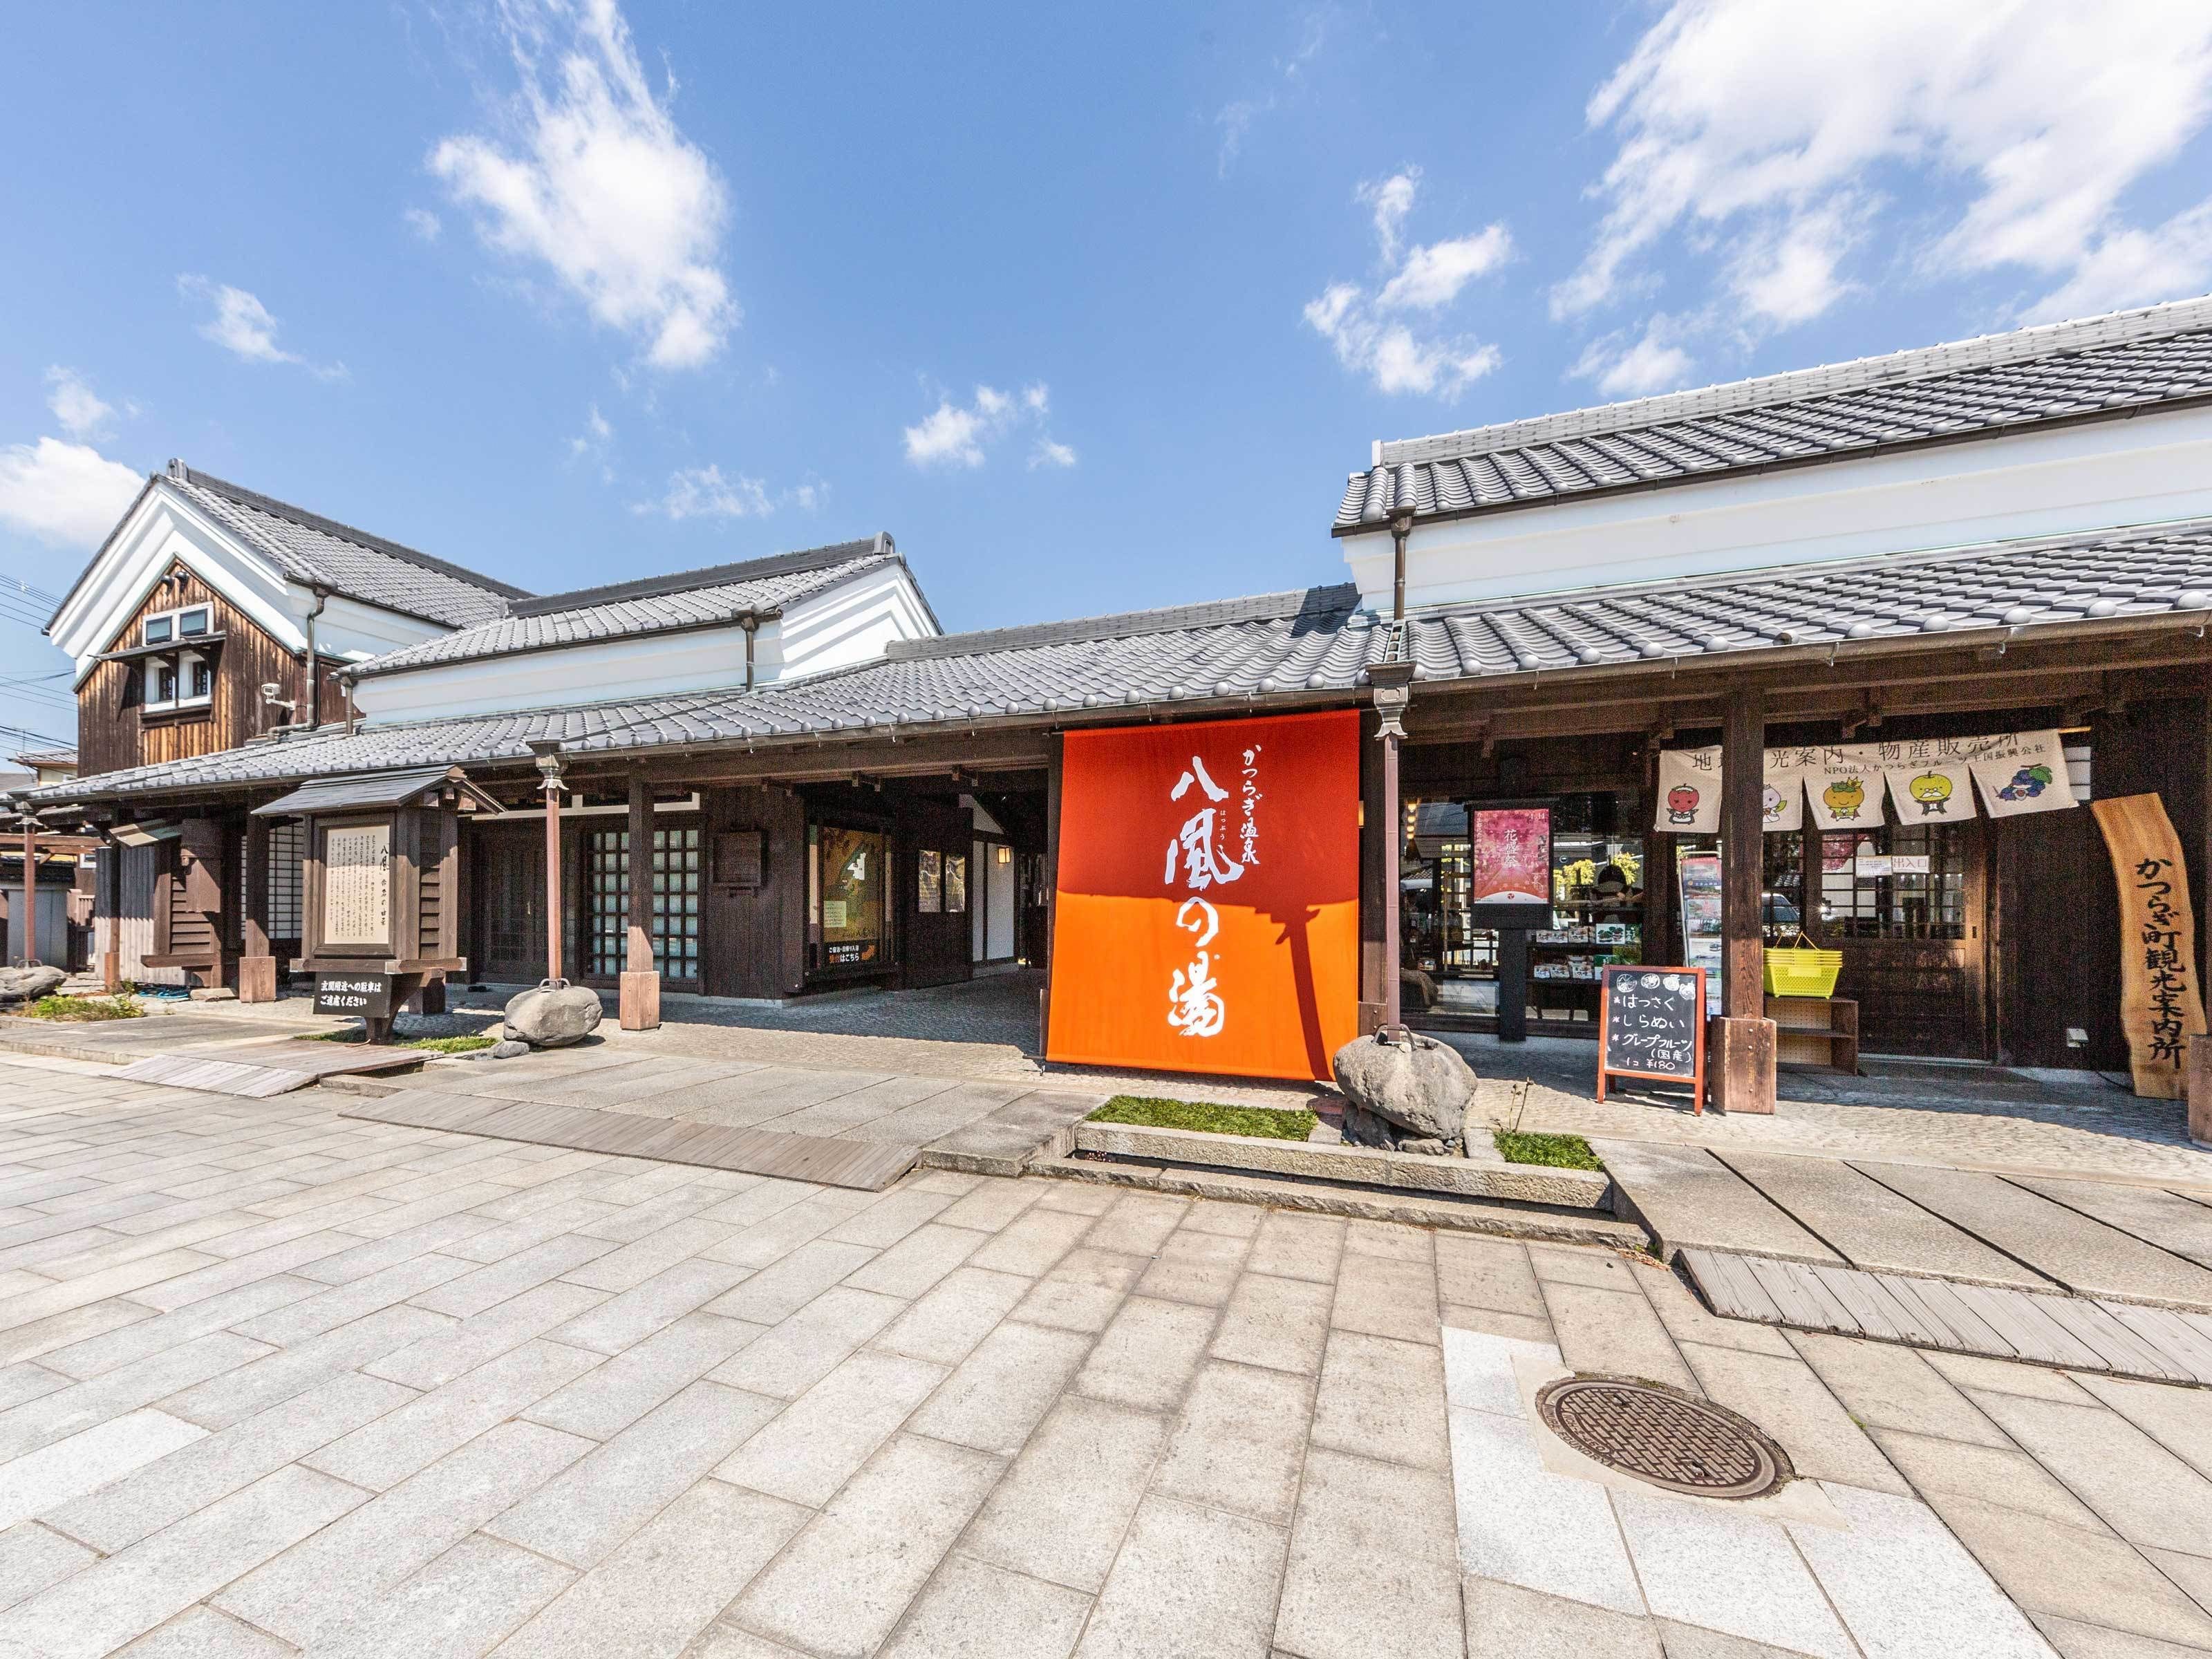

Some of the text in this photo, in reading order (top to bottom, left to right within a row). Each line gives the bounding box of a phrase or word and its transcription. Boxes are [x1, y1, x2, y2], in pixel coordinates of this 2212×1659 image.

[1239, 744, 1263, 865] かつらぎ温泉
[1503, 830, 1519, 868] 花盛祭
[1894, 857, 1927, 869] 出入口
[1164, 756, 1244, 1038] 八風の湯
[2135, 859, 2186, 1069] かつらぎ町観光案内所
[320, 995, 367, 1006] ご遠慮ください
[1624, 1014, 1685, 1029] しらぬい
[1622, 1033, 1692, 1051] グレープフルーツ
